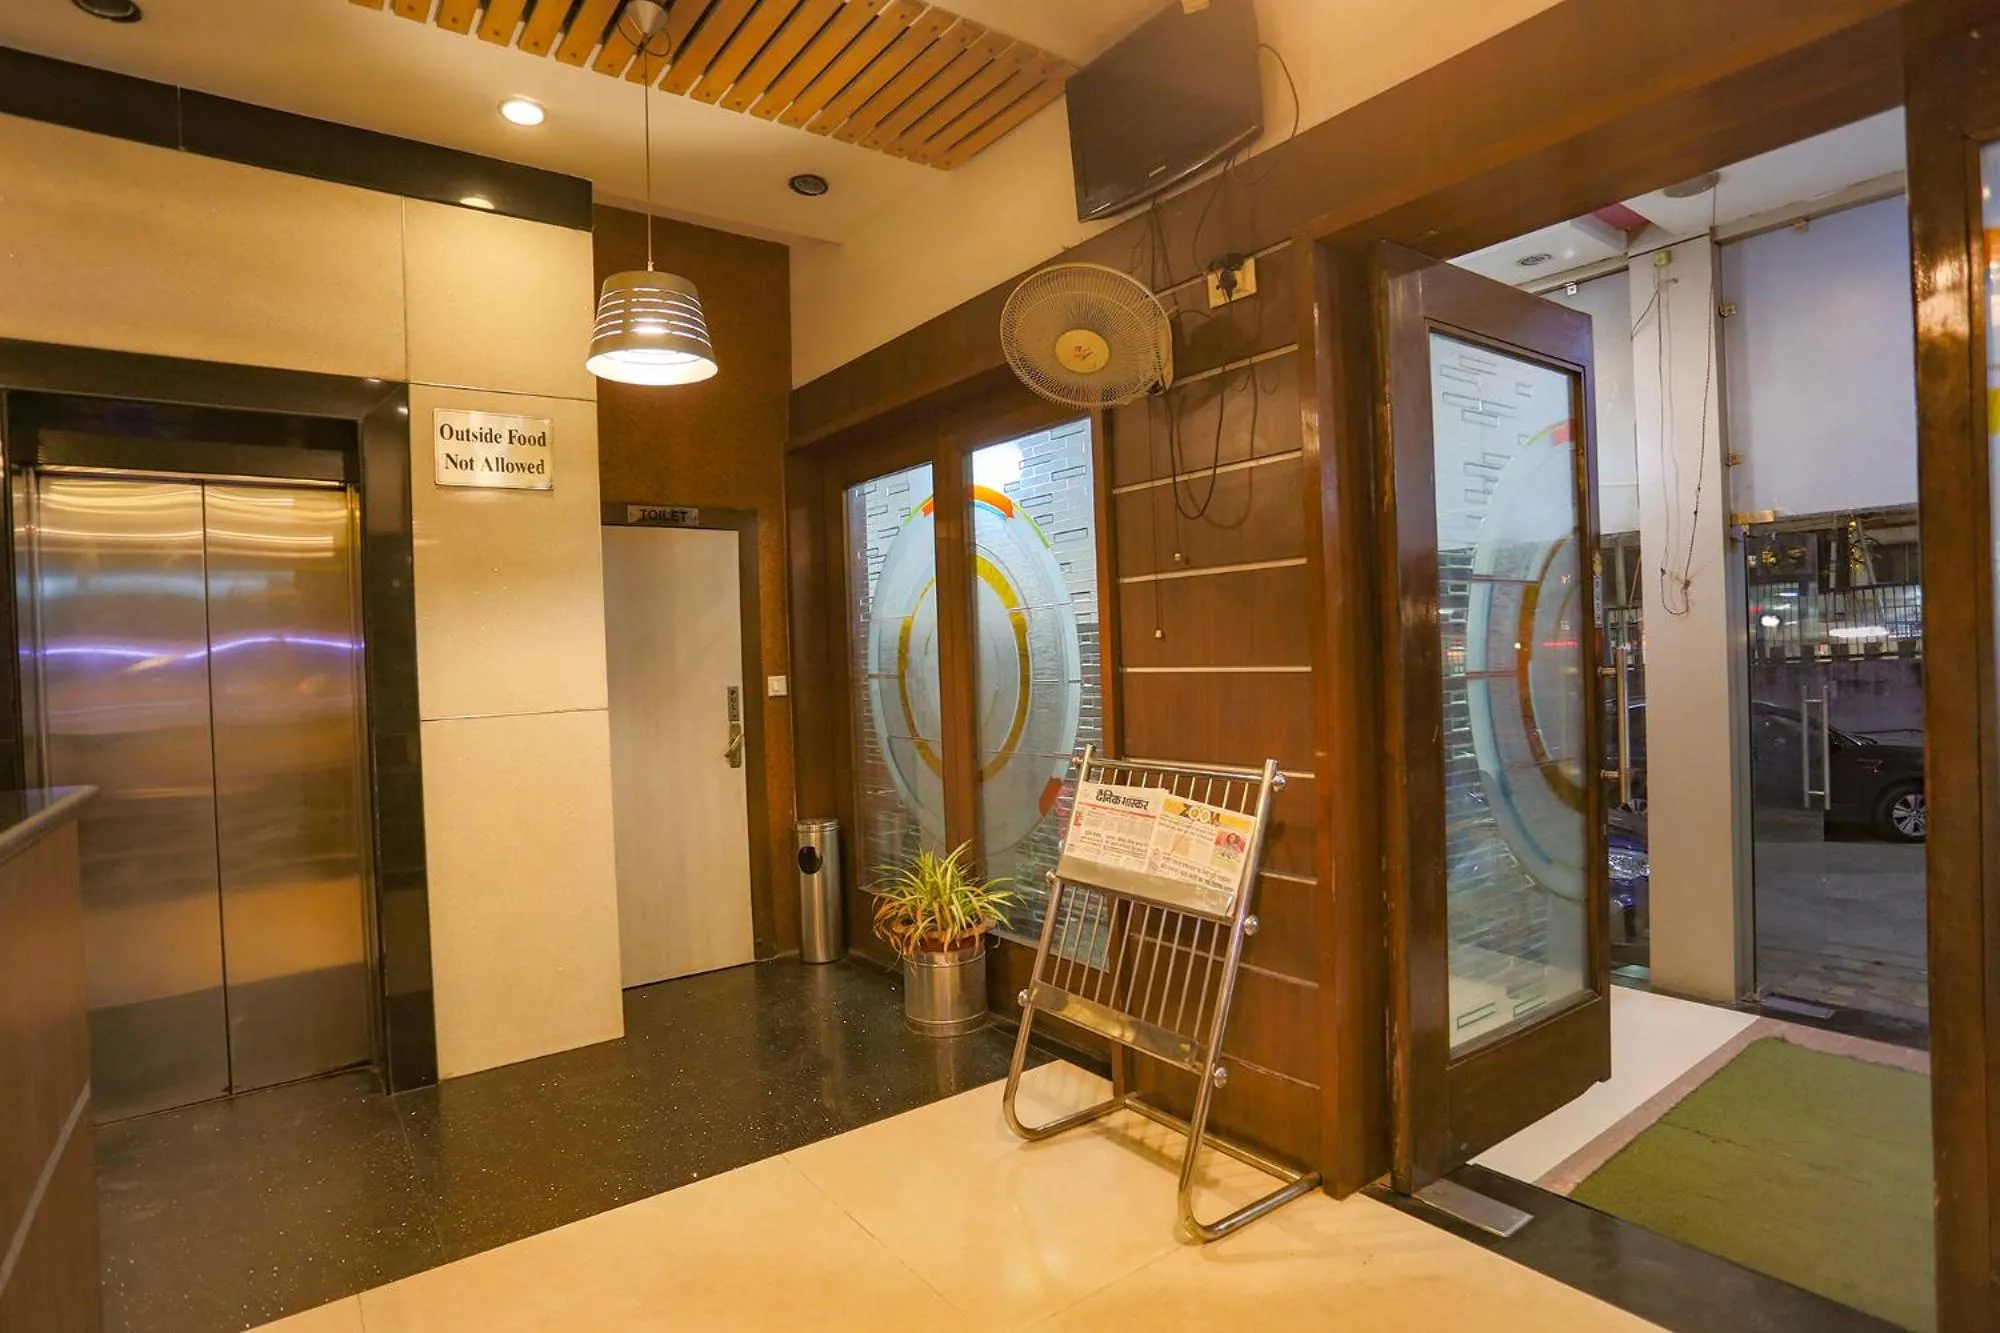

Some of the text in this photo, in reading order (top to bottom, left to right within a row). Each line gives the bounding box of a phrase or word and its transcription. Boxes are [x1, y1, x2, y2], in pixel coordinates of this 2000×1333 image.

[439, 423, 546, 447] Outside Food
[444, 453, 545, 475] Not Allowed
[639, 508, 688, 522] TOILET
